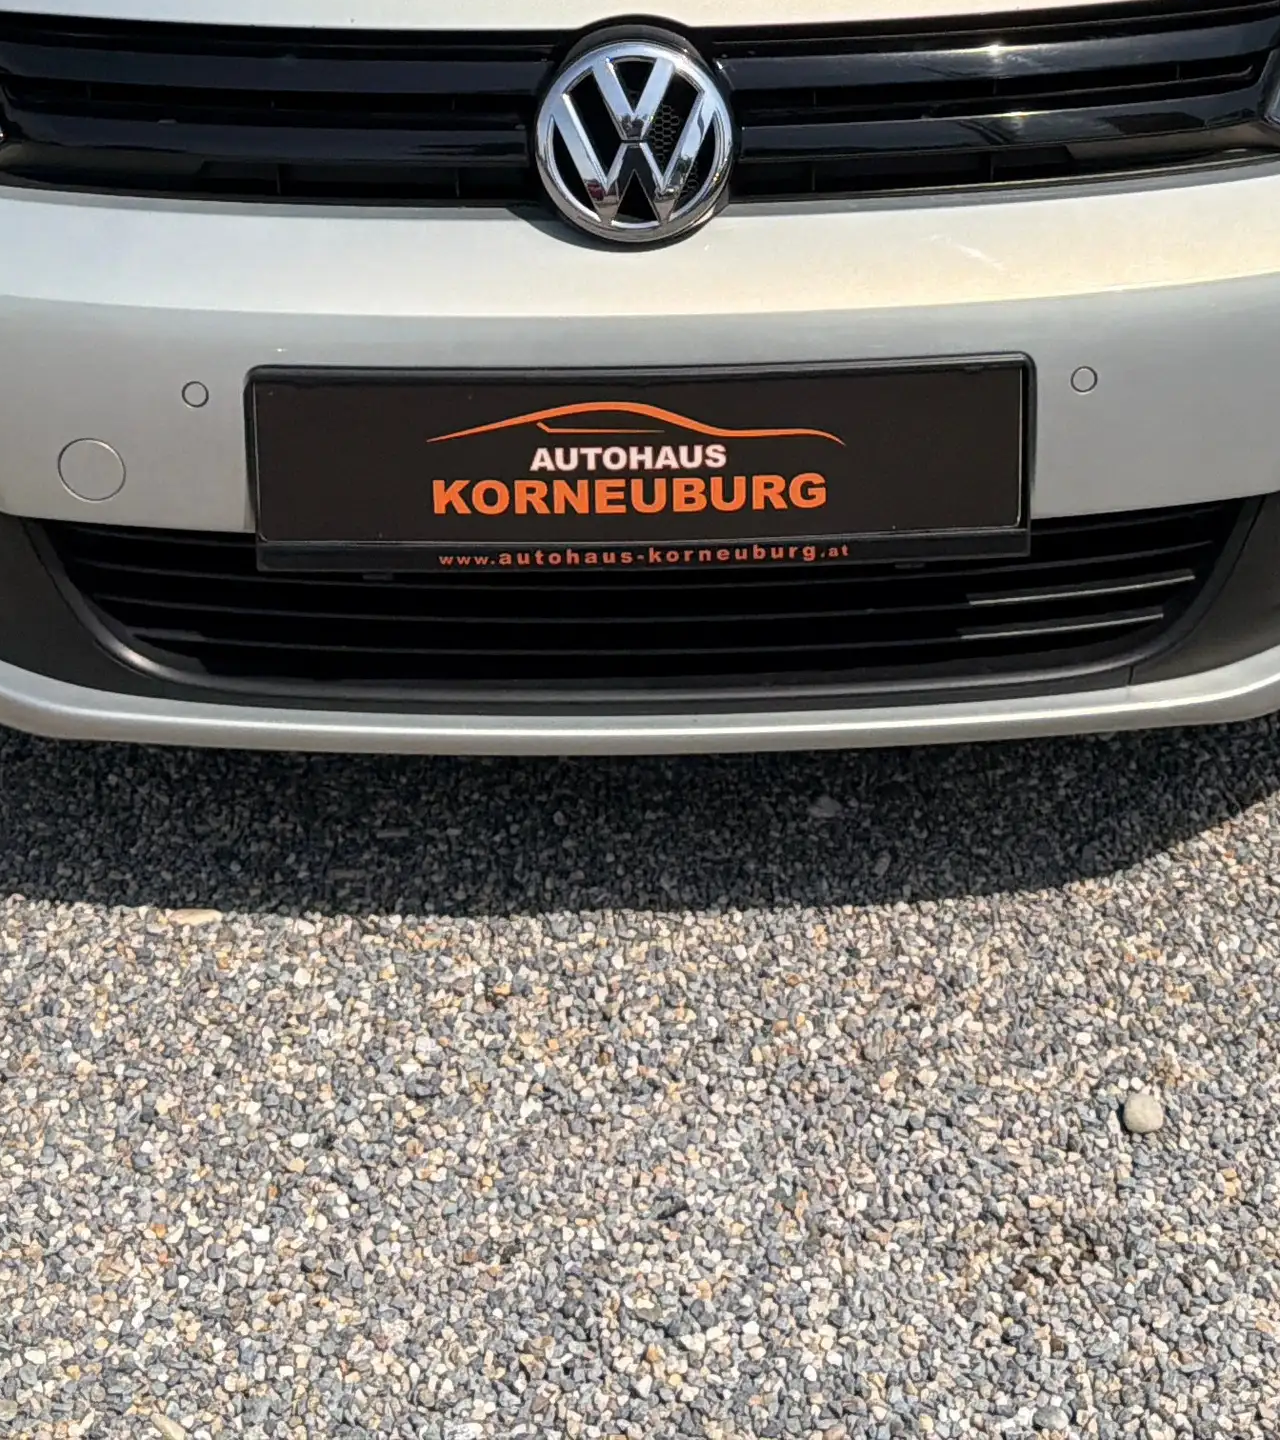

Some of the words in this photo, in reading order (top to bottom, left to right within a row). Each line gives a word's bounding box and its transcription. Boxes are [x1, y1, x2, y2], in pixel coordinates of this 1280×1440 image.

[529, 444, 727, 471] AUTOHAUS
[432, 472, 827, 515] KORNEUBURG
[438, 543, 849, 565] www.autohaus-korneuburg.at
